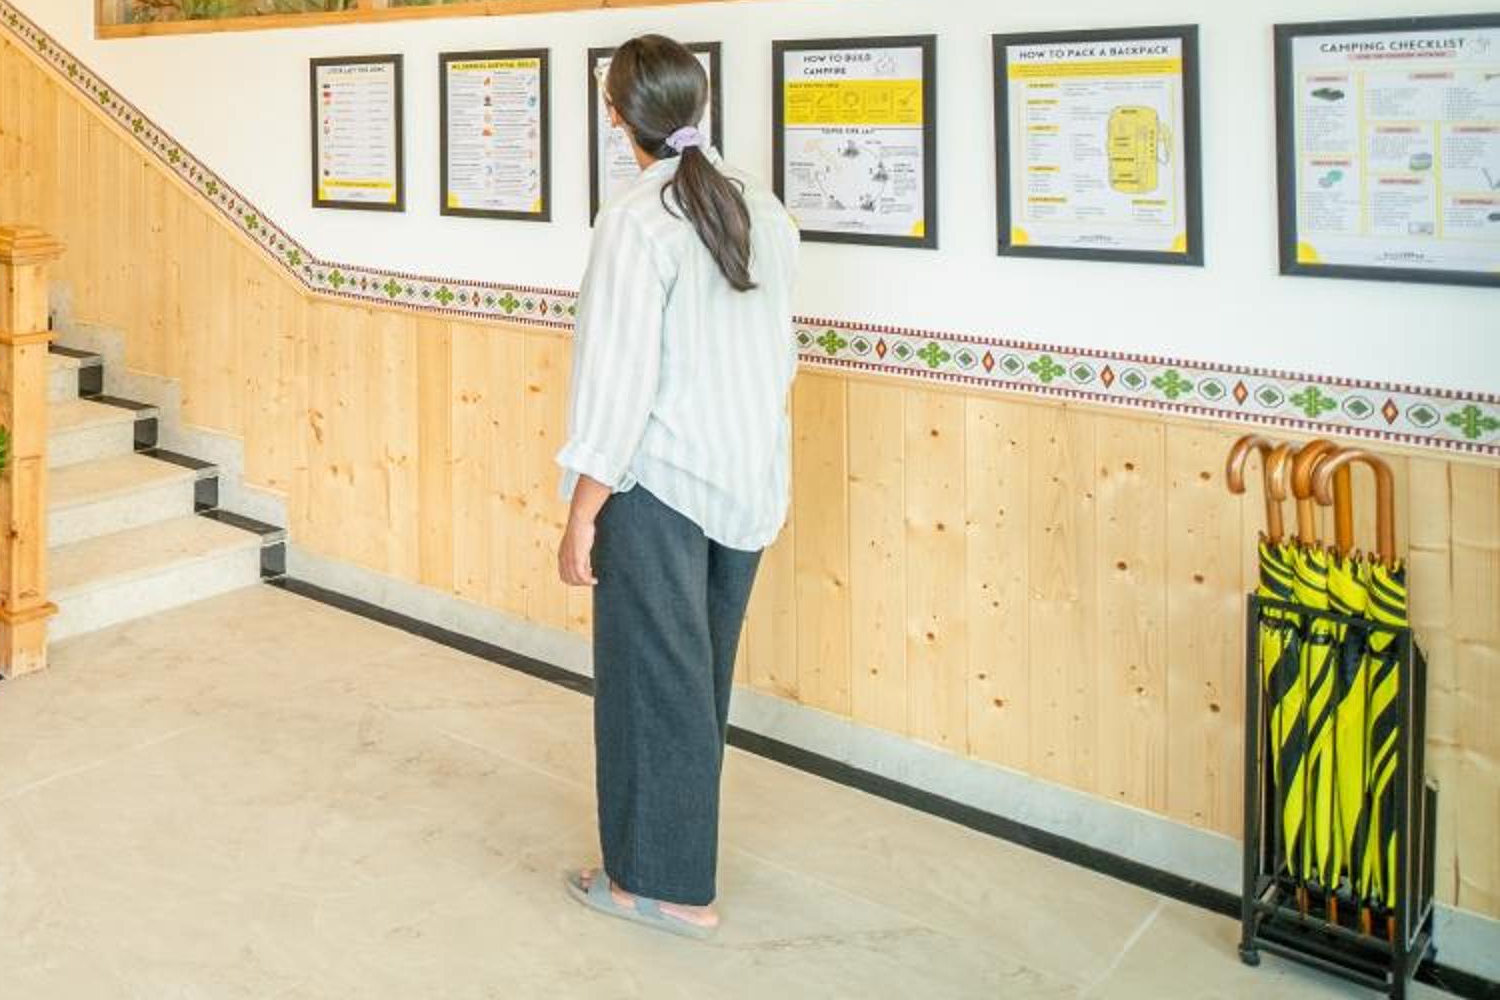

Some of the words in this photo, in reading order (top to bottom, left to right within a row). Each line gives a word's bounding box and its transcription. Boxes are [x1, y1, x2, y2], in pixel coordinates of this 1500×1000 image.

[1319, 42, 1385, 53] CAMPING
[1390, 38, 1465, 51] CHECKLIST
[803, 55, 826, 63] HOW
[829, 55, 841, 63] TO
[844, 53, 871, 62] BUILD
[1019, 50, 1045, 60] HOW
[1049, 50, 1064, 59] TO
[1067, 48, 1095, 58] PACK
[1099, 48, 1106, 57] A
[1109, 45, 1169, 56] BACKPACK
[803, 67, 847, 75] CAMPFIRE
